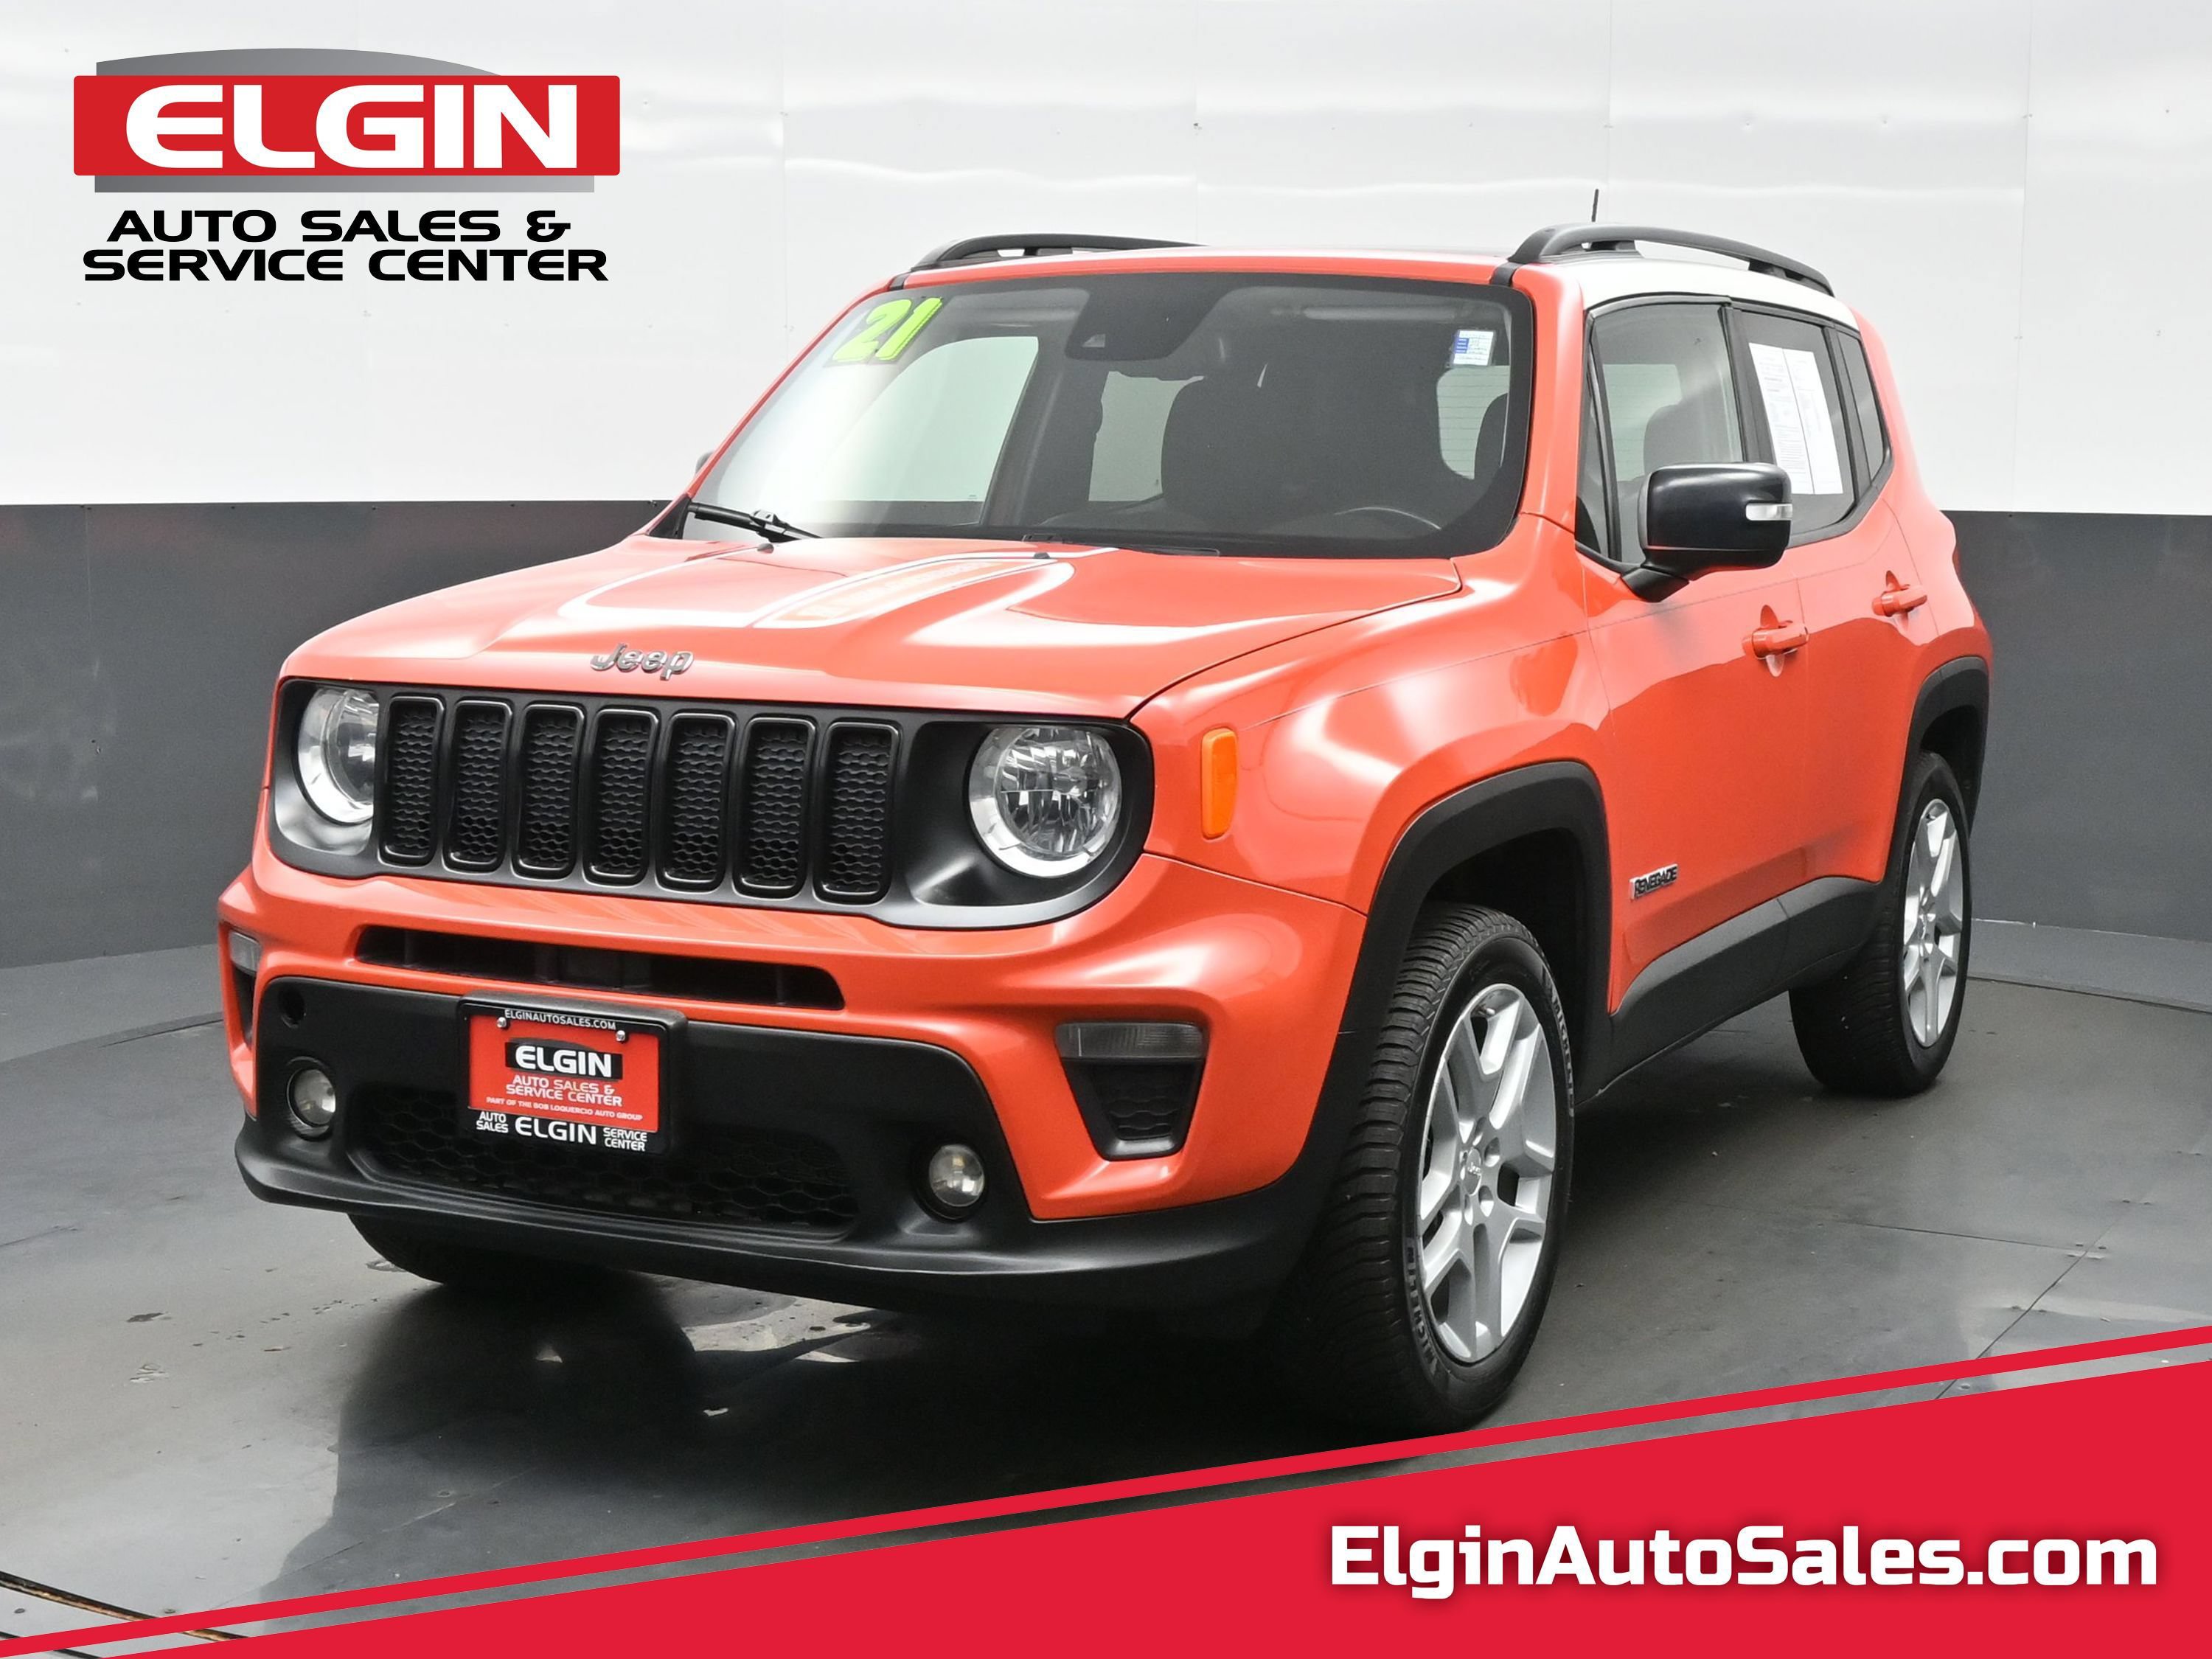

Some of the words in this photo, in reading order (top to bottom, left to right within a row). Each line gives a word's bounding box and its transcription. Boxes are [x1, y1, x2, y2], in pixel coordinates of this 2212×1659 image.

[832, 297, 942, 362] 21
[590, 642, 695, 682] Jeep
[1632, 864, 1678, 899] RENEGADE
[504, 1009, 616, 1030] ELGINAUTOSALES.COM
[516, 1046, 611, 1077] ELGIN
[507, 1085, 563, 1100] SERVICE
[568, 1092, 622, 1106] CENTER
[512, 1075, 549, 1088] AUTO
[554, 1079, 599, 1093] SALES
[603, 1084, 615, 1096] &
[479, 1110, 507, 1124] AUTO
[486, 1096, 506, 1106] PART
[507, 1099, 517, 1107] OF
[518, 1100, 532, 1108] THE
[594, 1109, 616, 1119] AUTO
[616, 1113, 644, 1121] GROUP
[476, 1121, 508, 1133] SALES
[515, 1116, 597, 1144] ELGIN
[603, 1127, 647, 1142] SERVICE
[605, 1137, 645, 1152] CENTER
